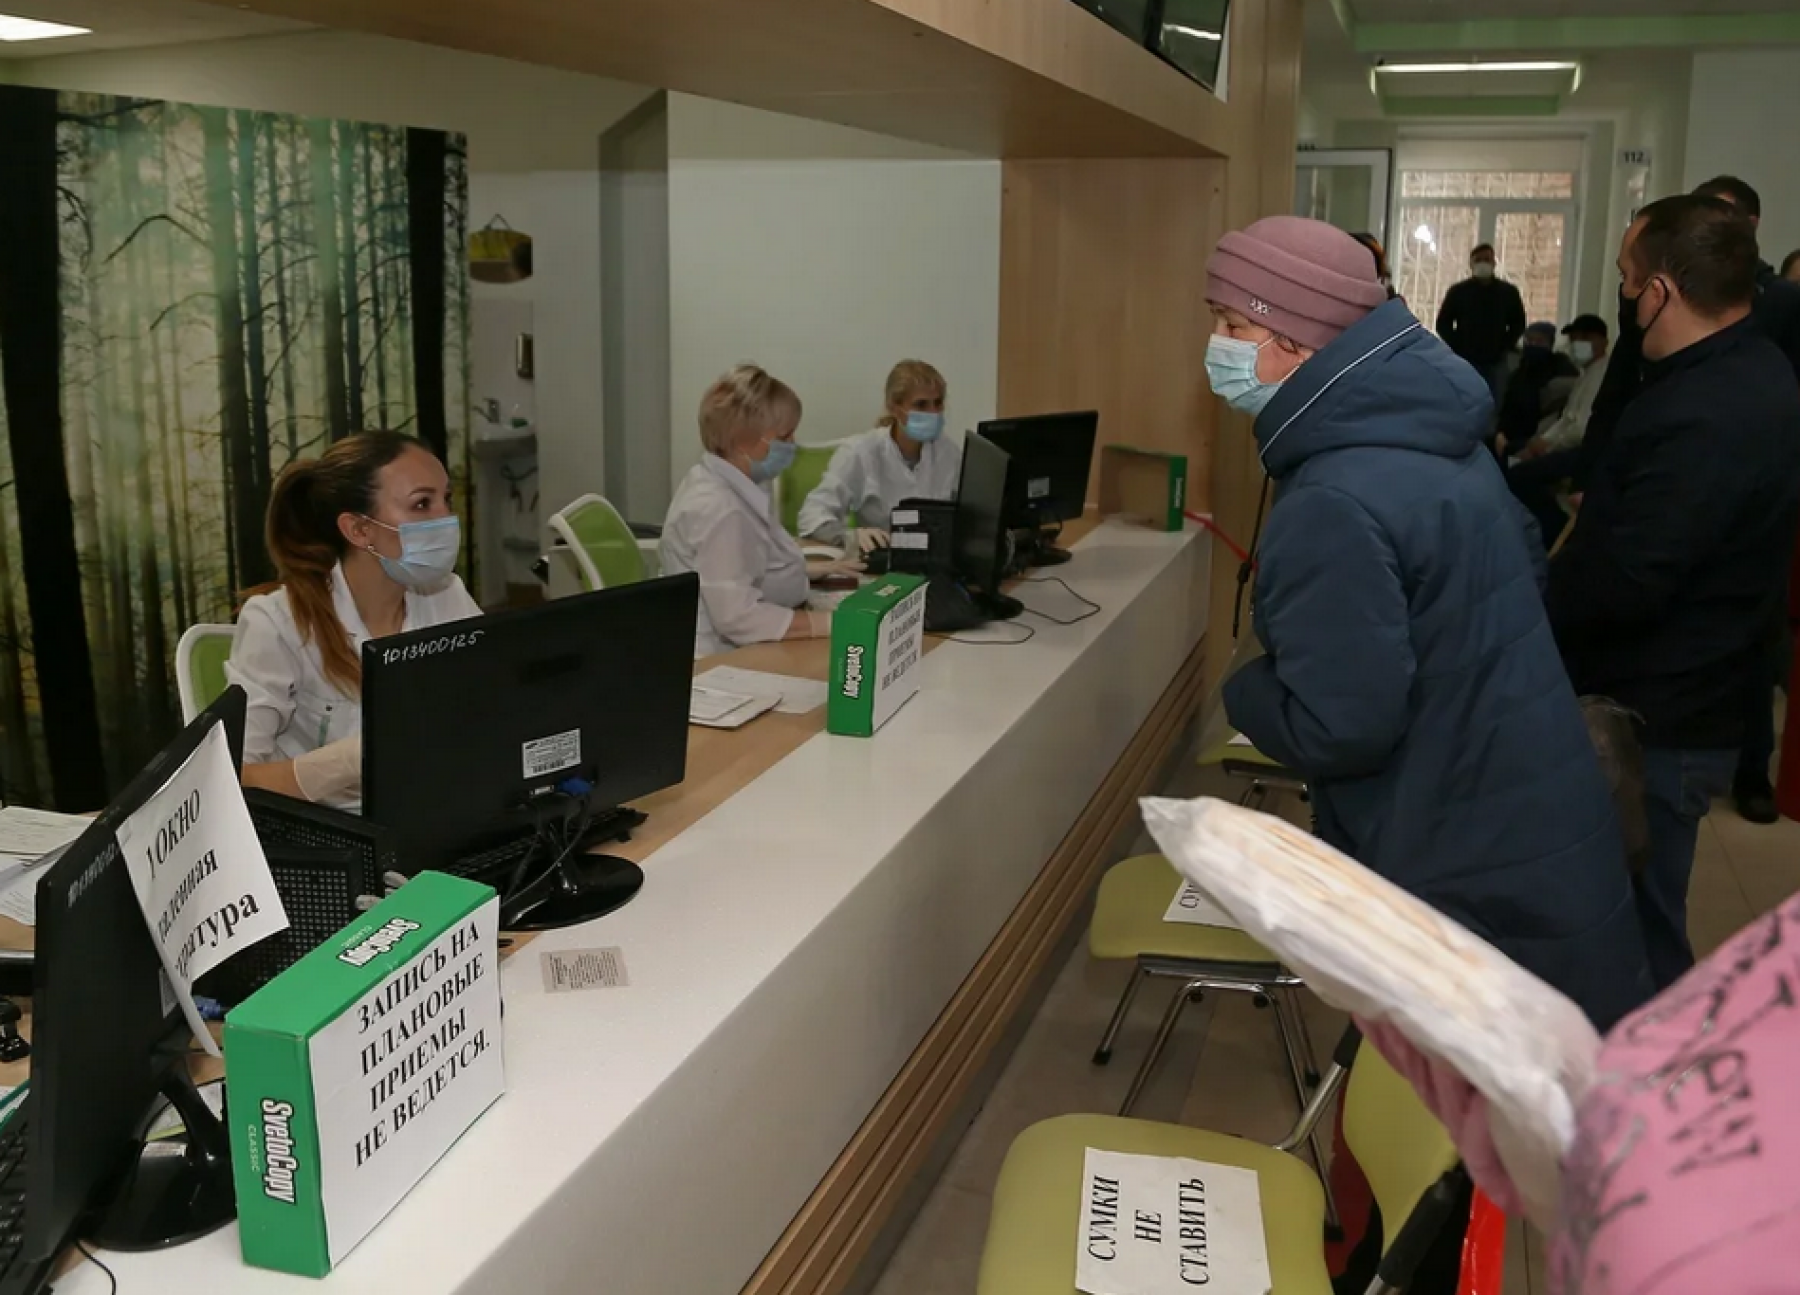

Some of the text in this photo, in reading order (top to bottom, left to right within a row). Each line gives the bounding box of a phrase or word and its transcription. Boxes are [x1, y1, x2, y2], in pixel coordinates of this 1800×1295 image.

[1624, 151, 1644, 164] 112
[156, 789, 200, 865] ОКНО
[358, 921, 480, 1034] ЗАПИСЬ НА
[360, 952, 485, 1077] ПЛАНОВЫЕ
[354, 1028, 490, 1168] НЕ ВЕДЕТСЯ.
[370, 1007, 467, 1113] ПРИЕМЫ
[247, 1124, 261, 1172] CLASSIC
[261, 1098, 299, 1206] SvetoCopy
[1087, 1175, 1119, 1262] СУМКИ
[1134, 1209, 1161, 1244] НЕ
[1179, 1178, 1210, 1286] СТАВИТЬ
